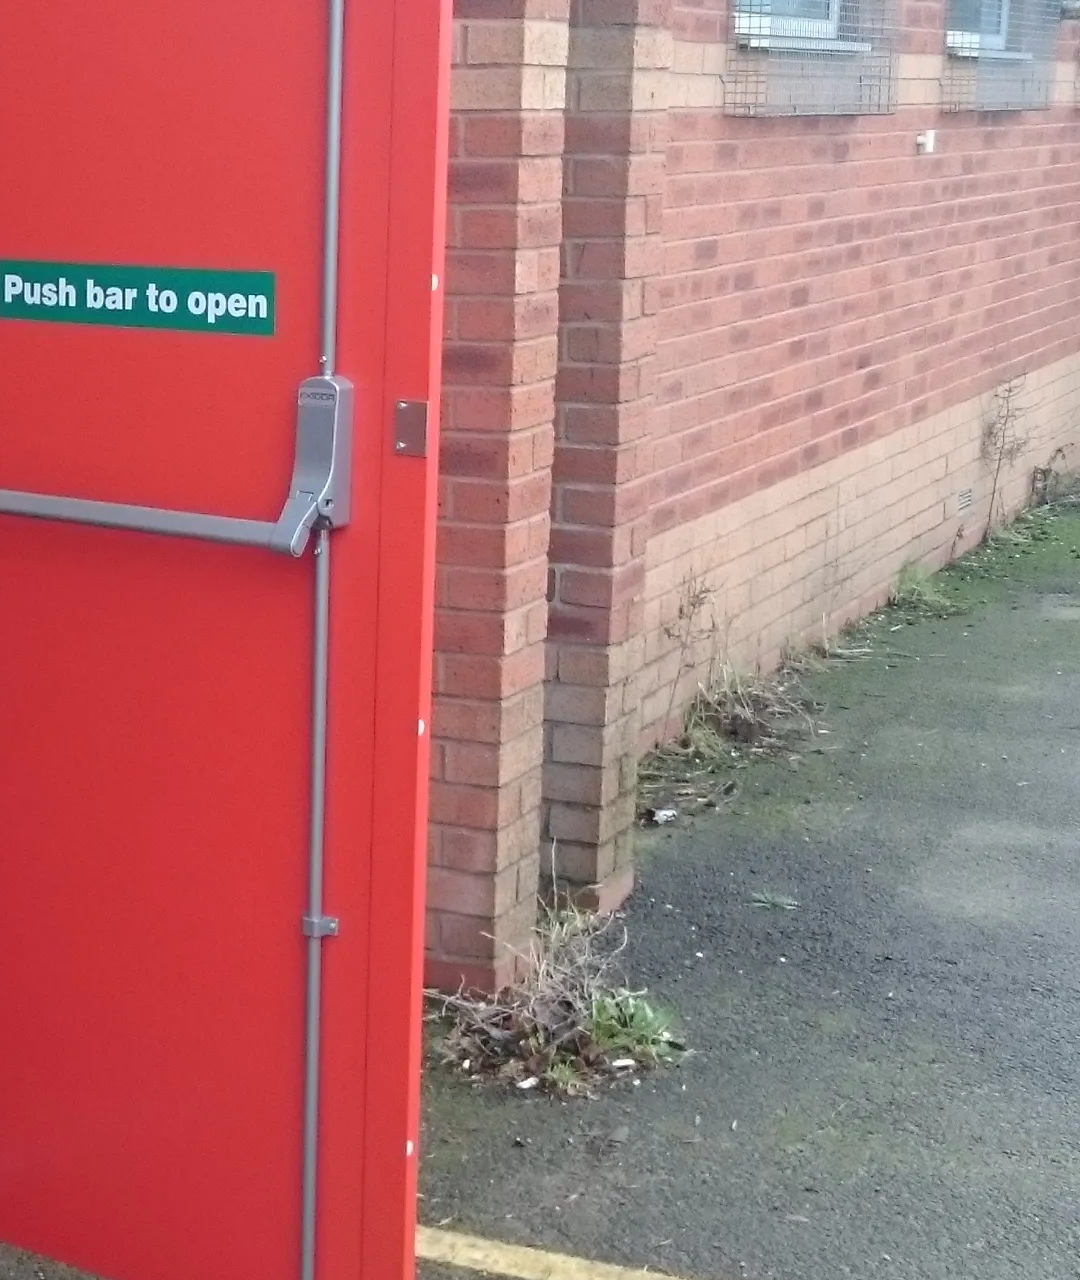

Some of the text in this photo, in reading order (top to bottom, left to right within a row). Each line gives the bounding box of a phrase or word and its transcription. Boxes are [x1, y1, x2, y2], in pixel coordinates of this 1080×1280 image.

[4, 274, 268, 323] Push bar to open
